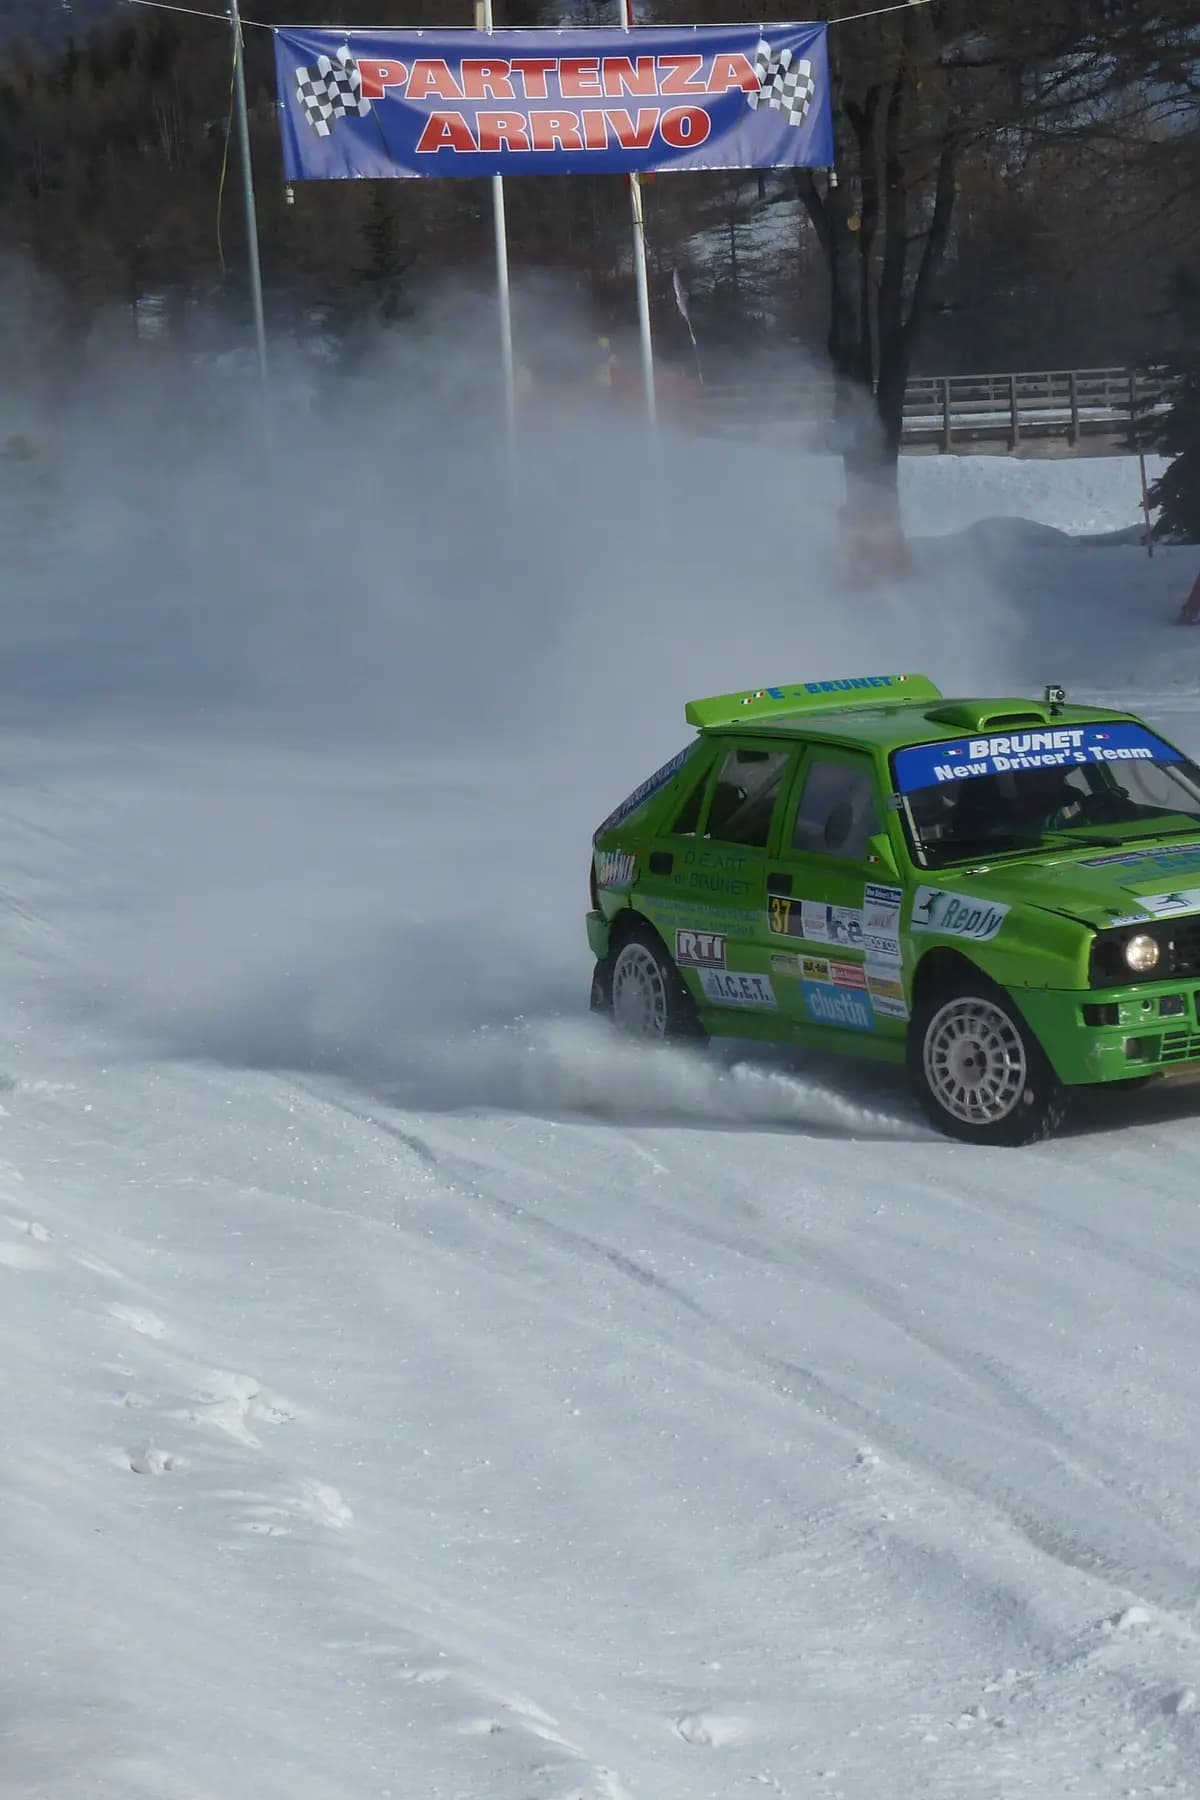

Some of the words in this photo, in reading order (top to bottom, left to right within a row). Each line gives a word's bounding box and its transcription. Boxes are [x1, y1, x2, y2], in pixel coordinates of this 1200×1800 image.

[356, 53, 761, 99] PARTENZA
[415, 105, 711, 153] ARRIVO
[804, 675, 893, 695] BRUNET
[969, 730, 1084, 759] BRUNET
[934, 760, 987, 781] New
[992, 749, 1087, 771] Driver's
[1089, 745, 1153, 760] Team
[689, 871, 754, 897] BRUNET
[771, 898, 791, 933] 37
[940, 898, 1003, 938] Reply
[678, 932, 723, 960] RTI
[714, 974, 770, 1001] I.C.E.T.
[810, 987, 869, 1027] clustin
